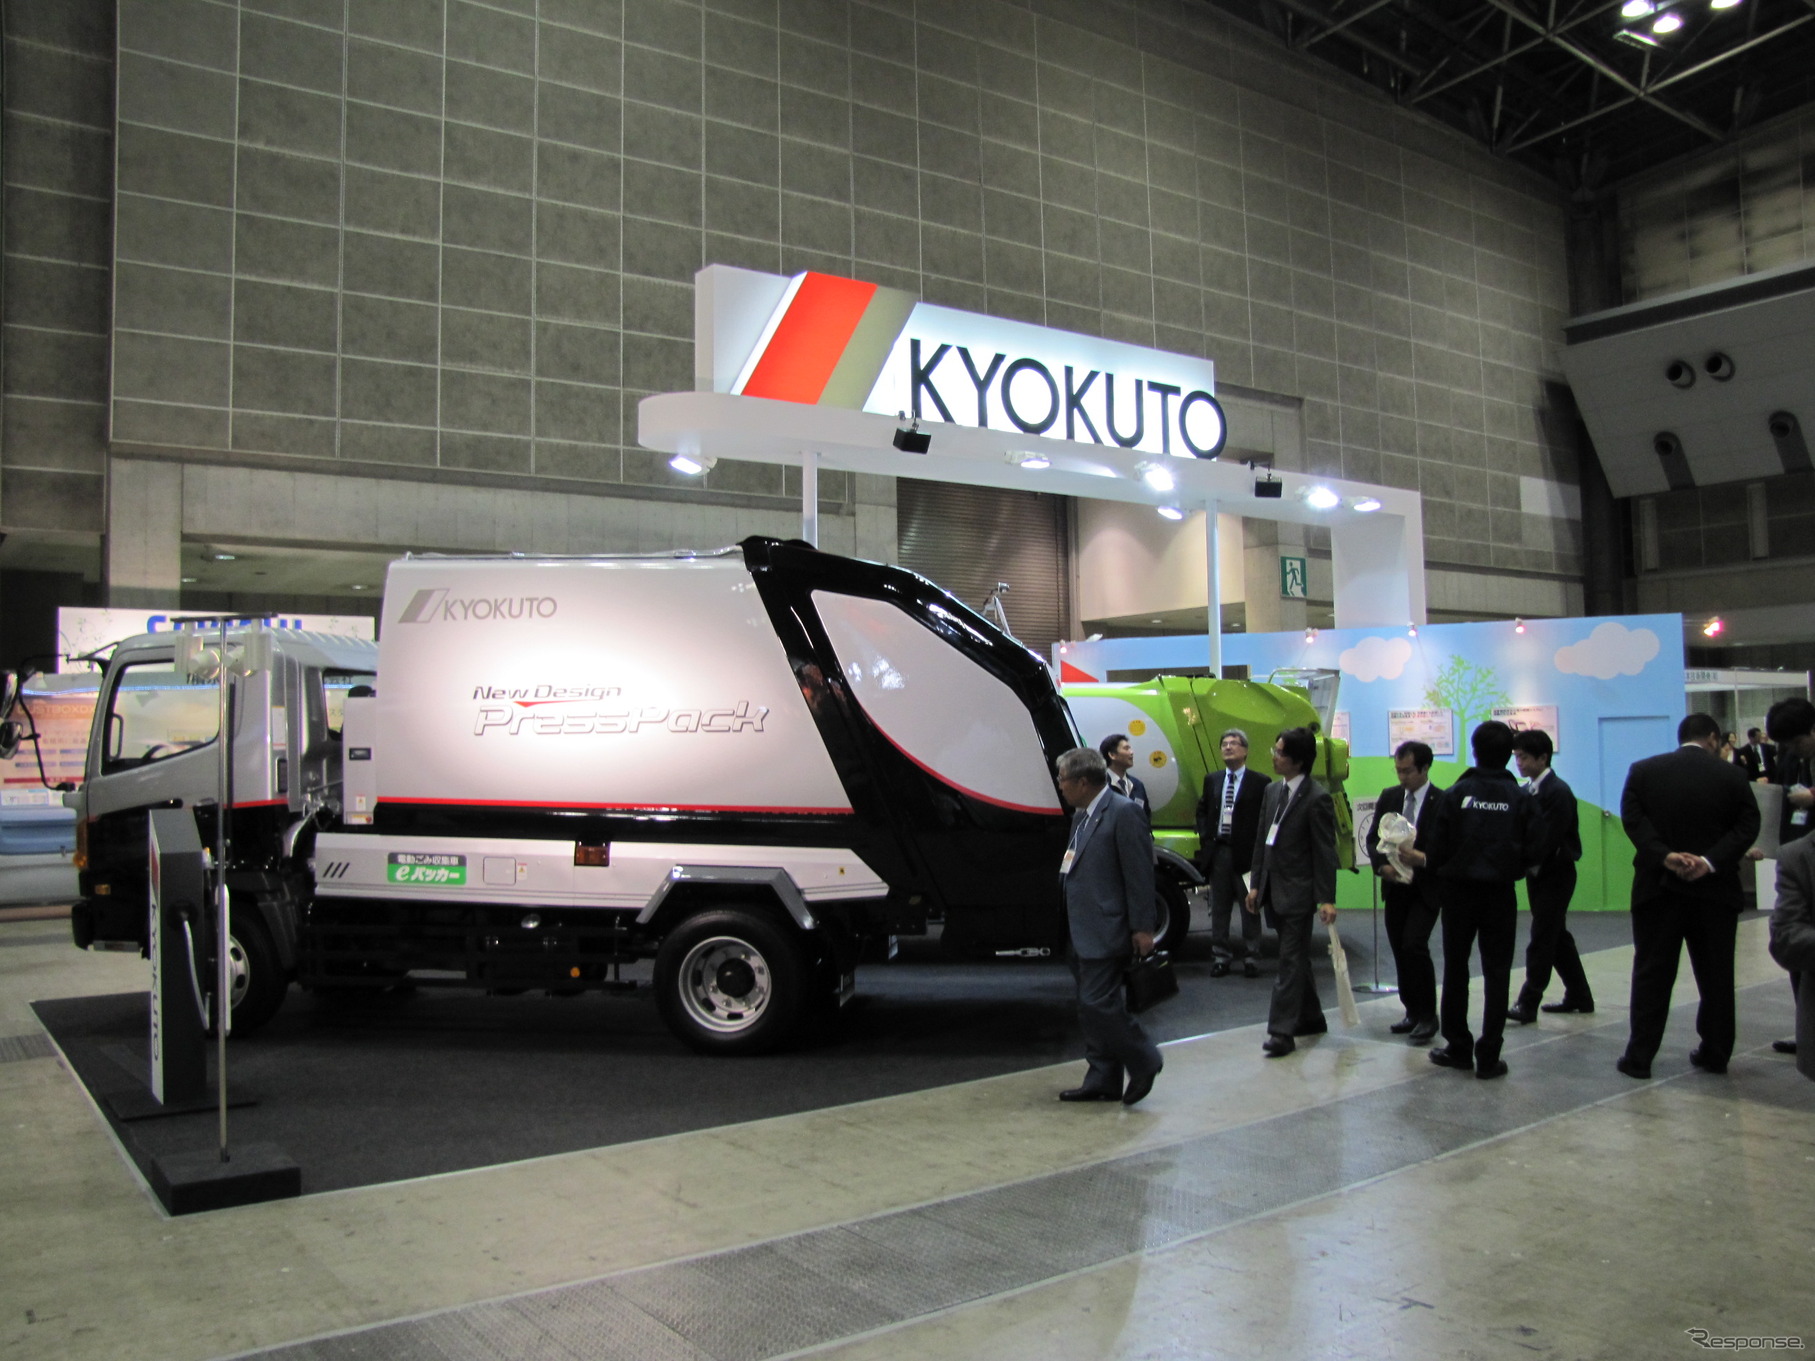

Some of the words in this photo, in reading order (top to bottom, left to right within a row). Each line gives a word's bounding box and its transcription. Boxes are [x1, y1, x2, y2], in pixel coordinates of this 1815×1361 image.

[909, 338, 1228, 460] KYOKUTO
[443, 596, 558, 621] KYOKUTO
[472, 684, 529, 701] New
[533, 684, 622, 701] Design
[473, 700, 770, 736] PressPack
[1472, 800, 1510, 812] KYOKUTO
[397, 854, 459, 866] 電動ごみ収集車
